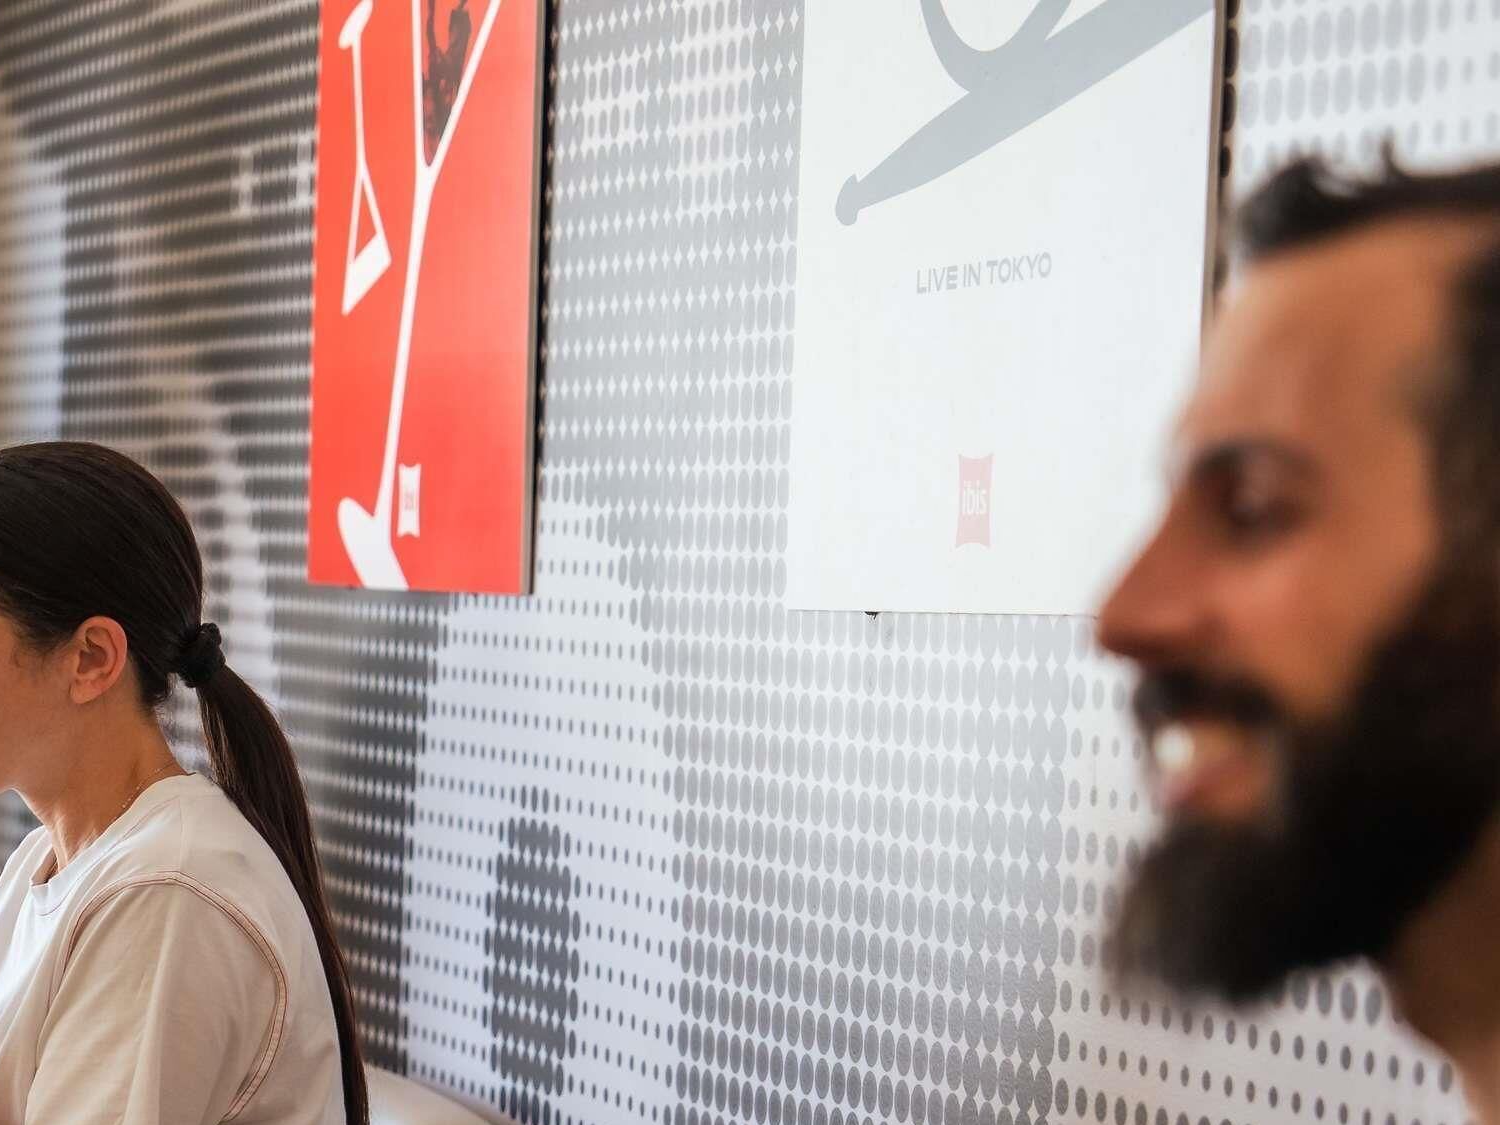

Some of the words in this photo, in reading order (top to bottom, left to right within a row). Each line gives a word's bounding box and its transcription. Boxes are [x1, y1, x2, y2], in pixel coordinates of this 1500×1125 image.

[916, 266, 958, 293] LIVE
[962, 262, 981, 288] IN
[986, 252, 1052, 285] TOKYO
